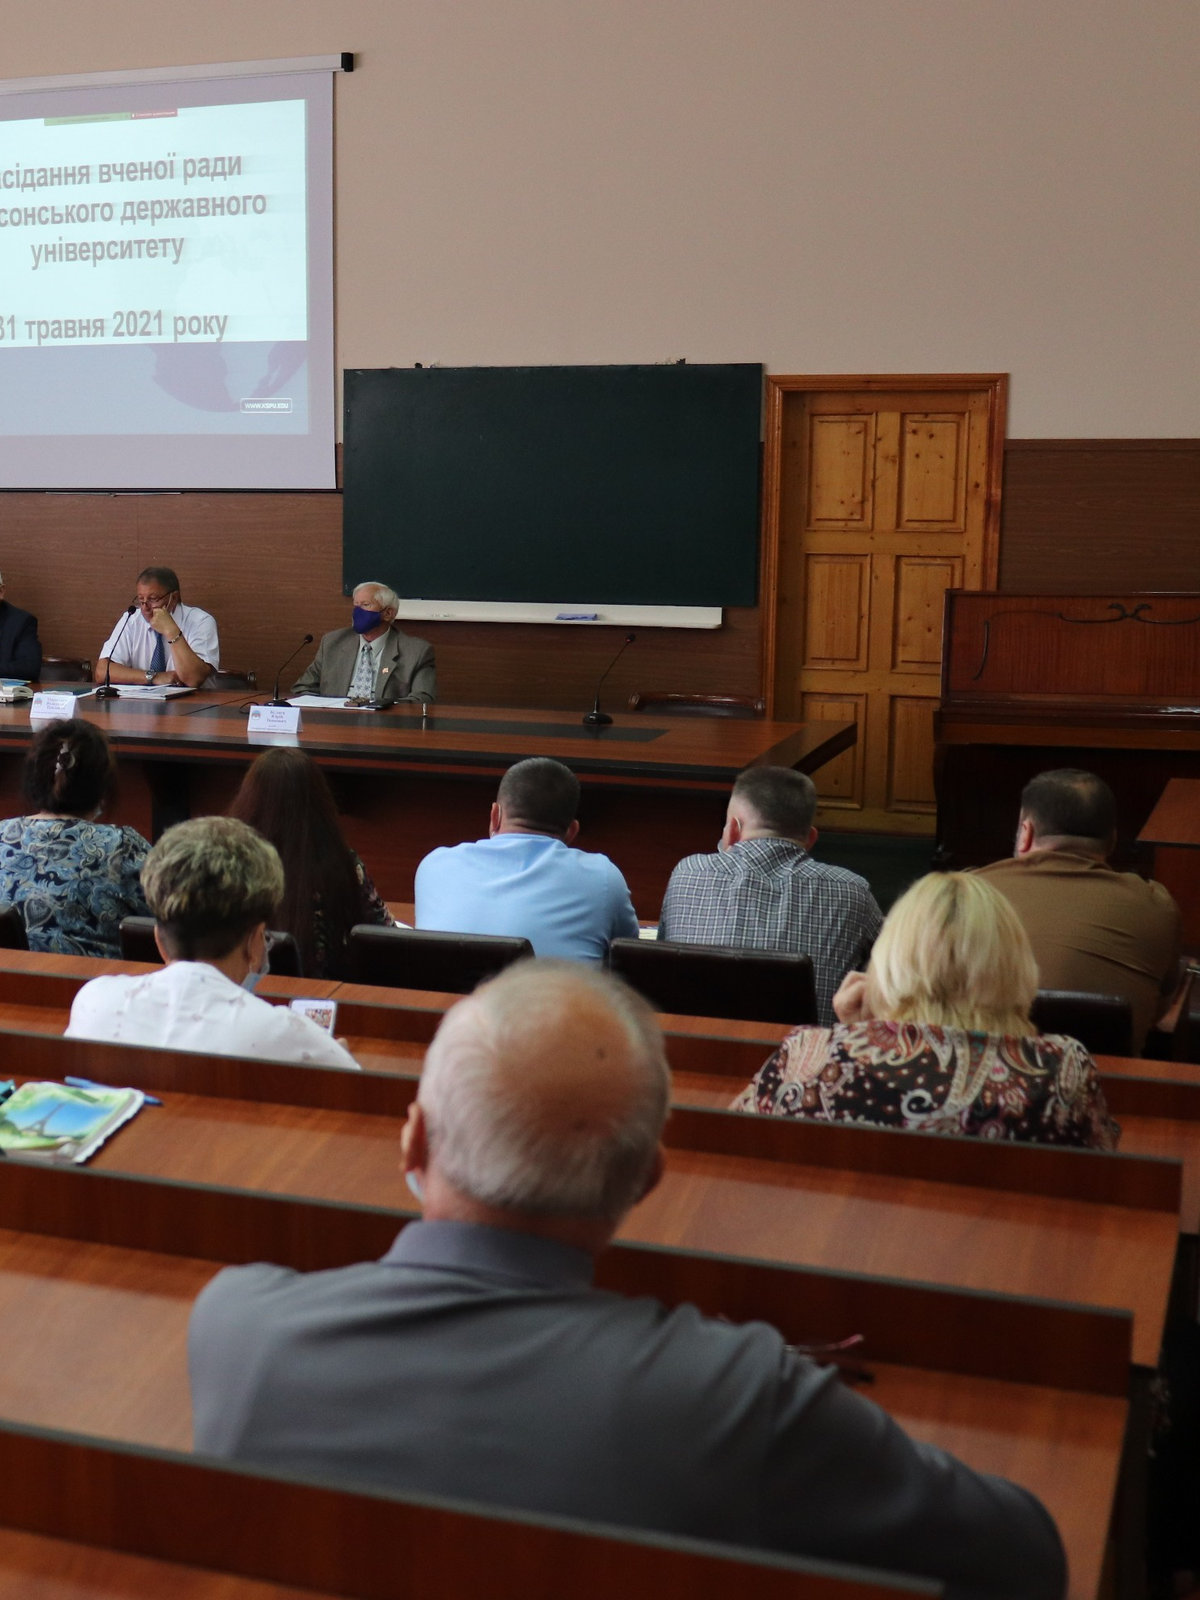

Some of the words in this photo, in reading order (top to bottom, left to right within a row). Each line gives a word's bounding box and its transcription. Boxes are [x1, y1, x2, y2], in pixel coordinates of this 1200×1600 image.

[99, 152, 176, 183] вченої
[182, 154, 243, 184] ради
[120, 194, 267, 227] державного
[31, 236, 184, 270] університету
[25, 316, 105, 345] травня
[112, 310, 163, 338] 2021
[173, 313, 229, 342] року
